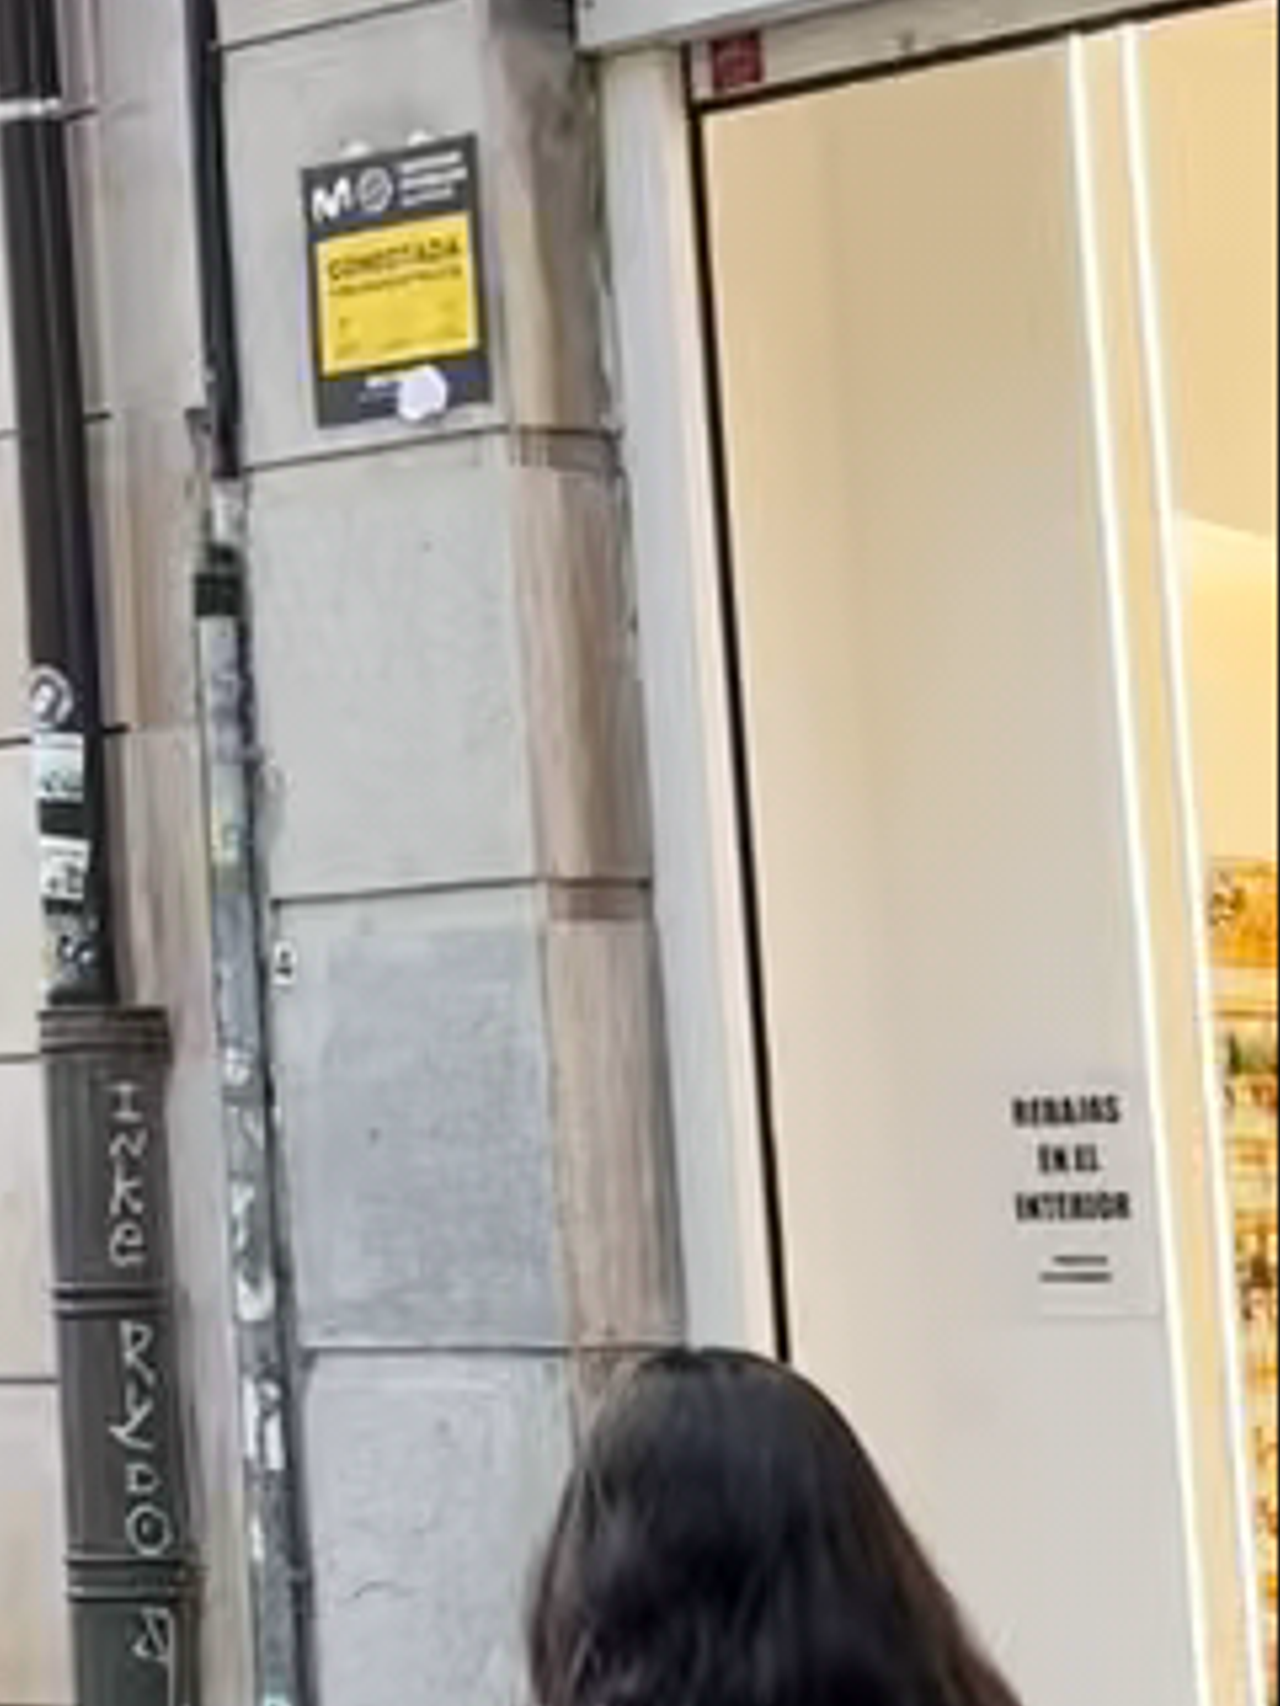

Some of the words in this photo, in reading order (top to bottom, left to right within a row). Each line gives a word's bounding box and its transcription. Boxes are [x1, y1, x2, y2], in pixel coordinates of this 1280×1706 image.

[1011, 1094, 1122, 1128] REBAJAS
[1037, 1142, 1069, 1174] EN
[1074, 1142, 1102, 1173] EL
[1014, 1190, 1132, 1223] INTERIOR
